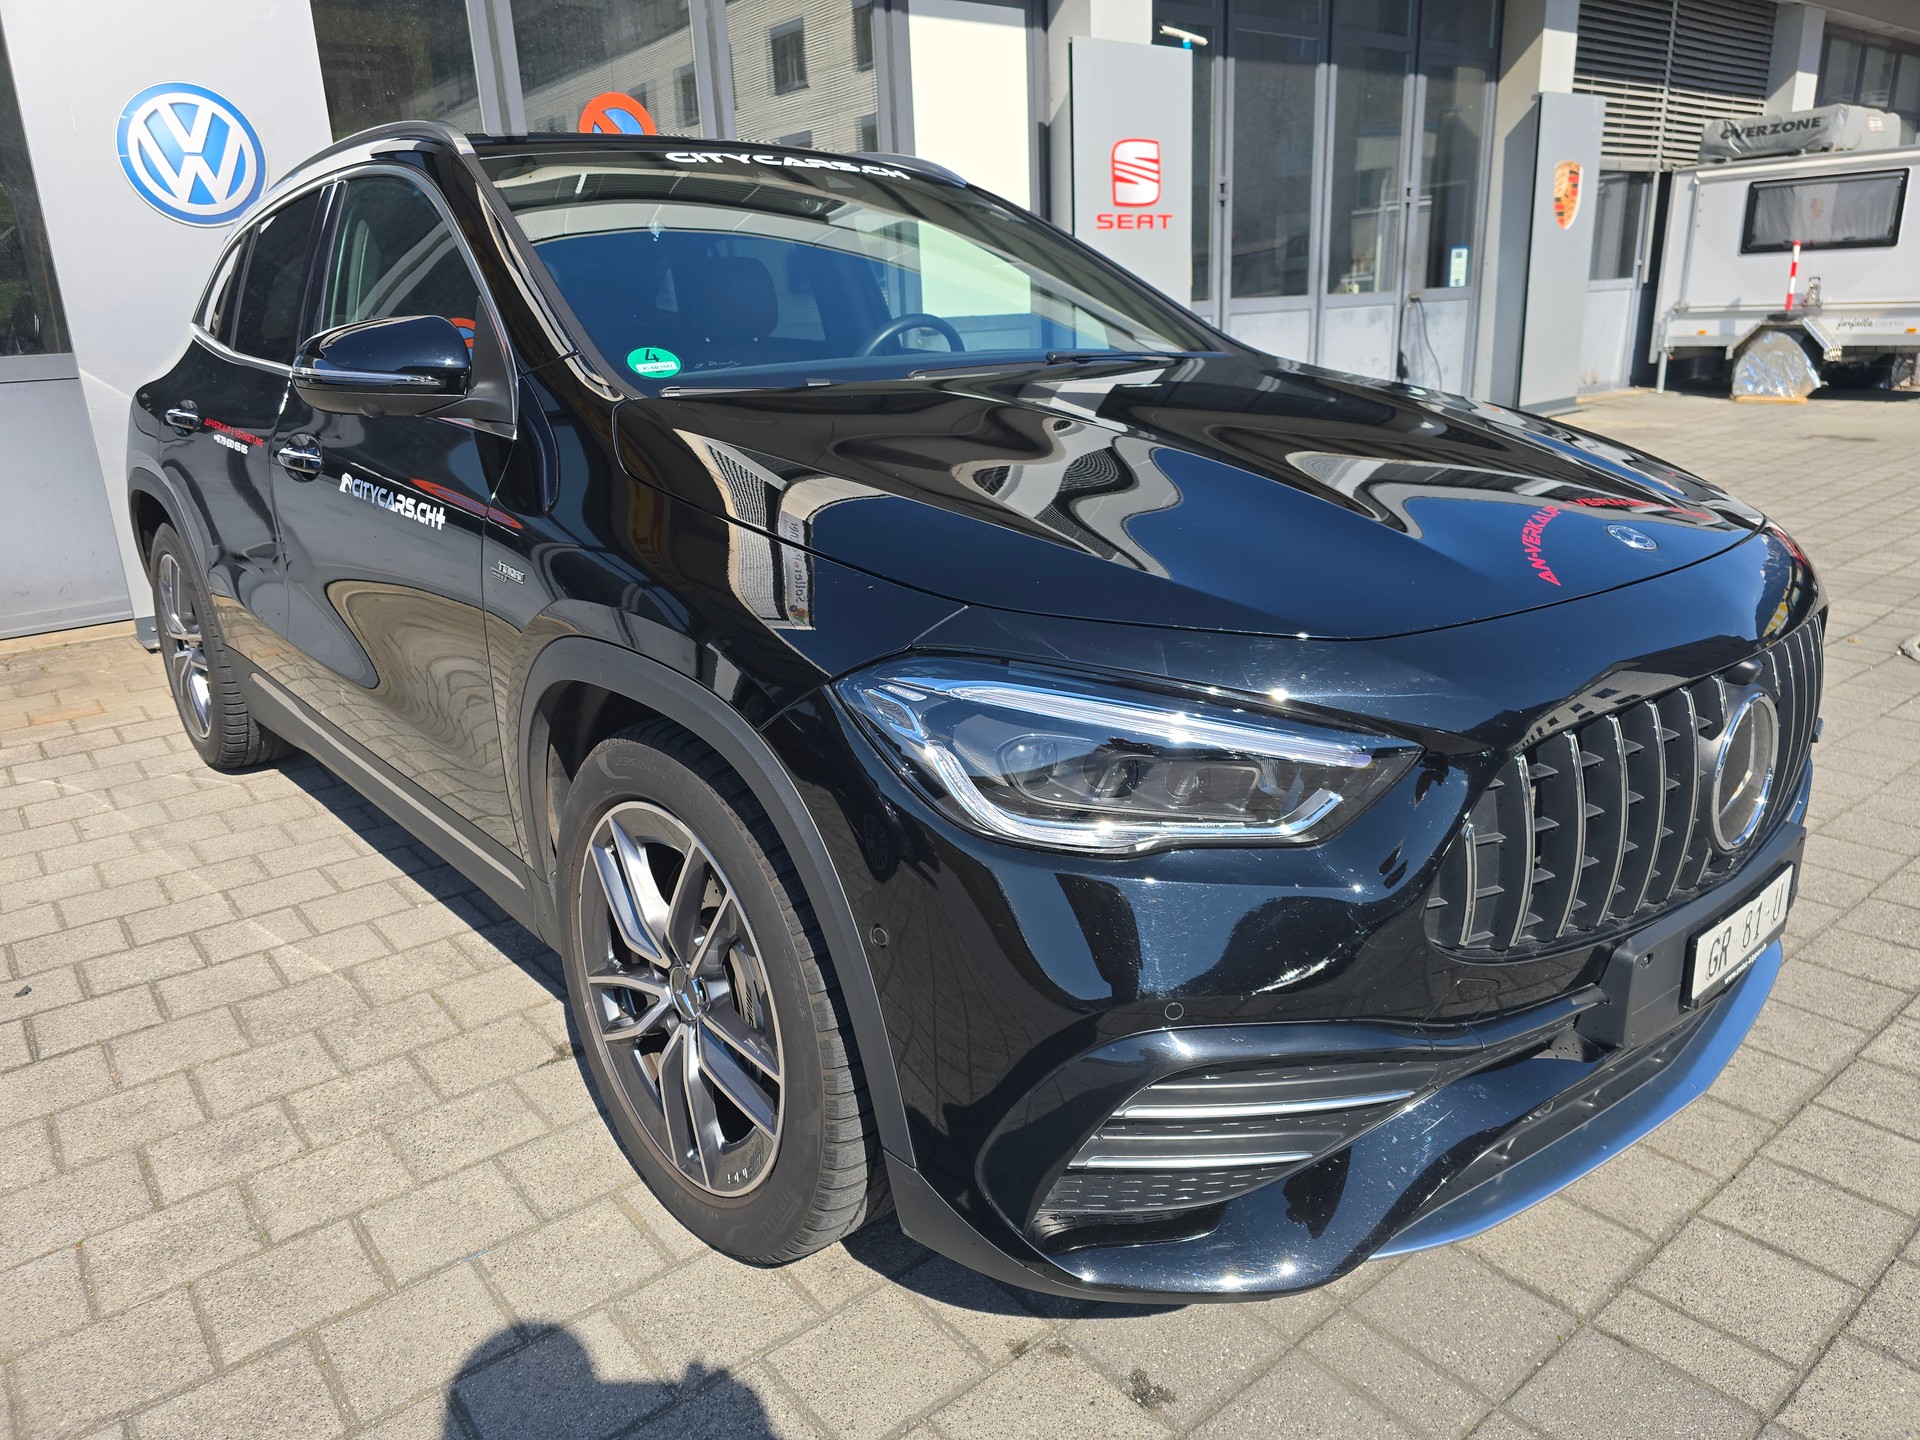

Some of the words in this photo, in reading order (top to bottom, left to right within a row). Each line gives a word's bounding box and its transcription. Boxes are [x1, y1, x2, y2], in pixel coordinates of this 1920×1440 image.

[1097, 213, 1173, 229] SEAT
[645, 349, 660, 362] 4
[351, 478, 437, 528] CITYCARS.CH
[1708, 925, 1732, 977] GR
